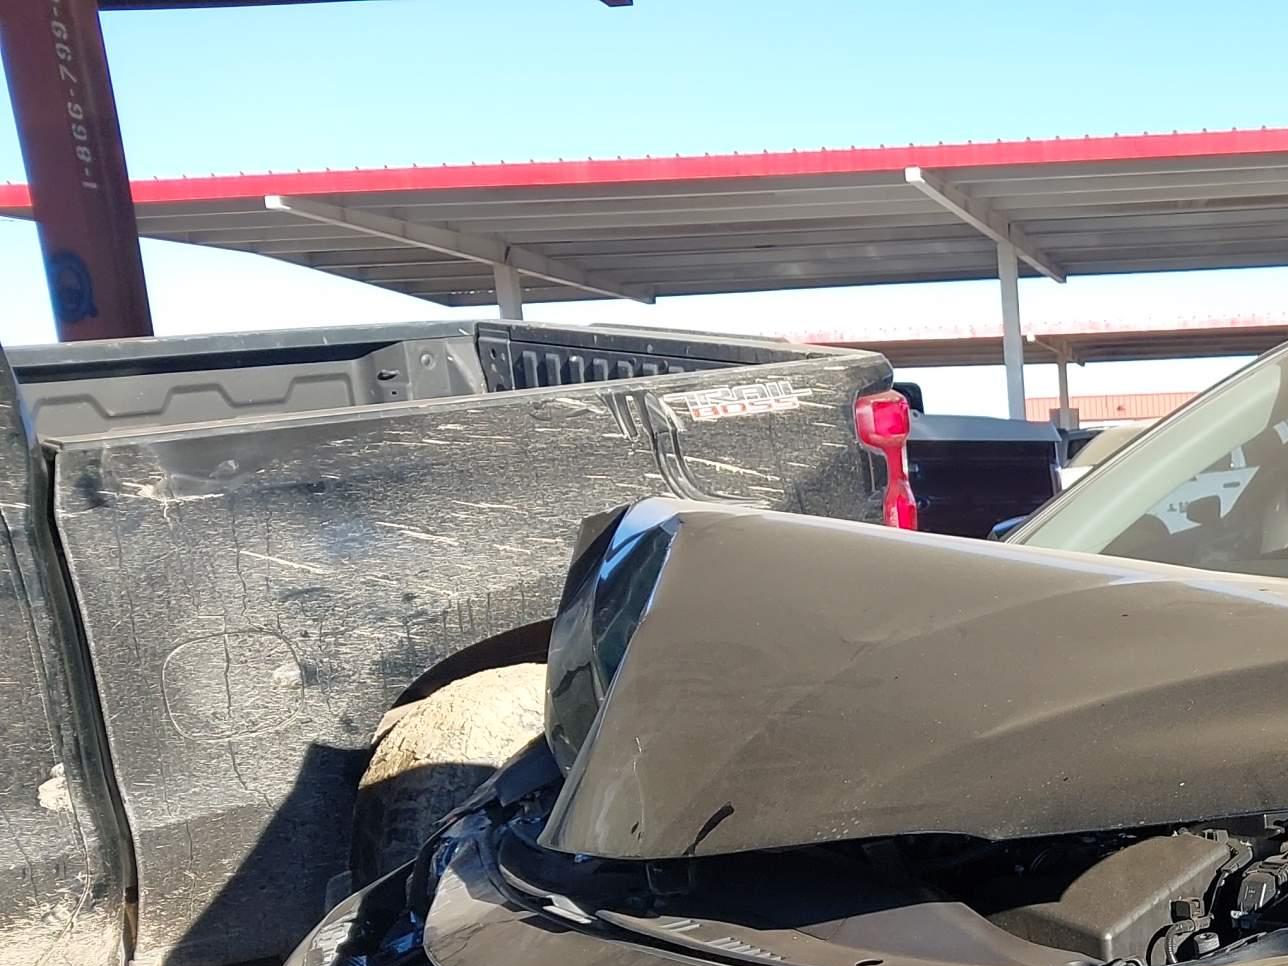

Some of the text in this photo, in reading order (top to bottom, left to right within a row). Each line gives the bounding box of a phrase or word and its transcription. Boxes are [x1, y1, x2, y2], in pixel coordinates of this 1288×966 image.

[51, 0, 98, 190] 1-866-799-
[663, 380, 813, 408] TRAIL
[690, 396, 800, 421] BOSS
